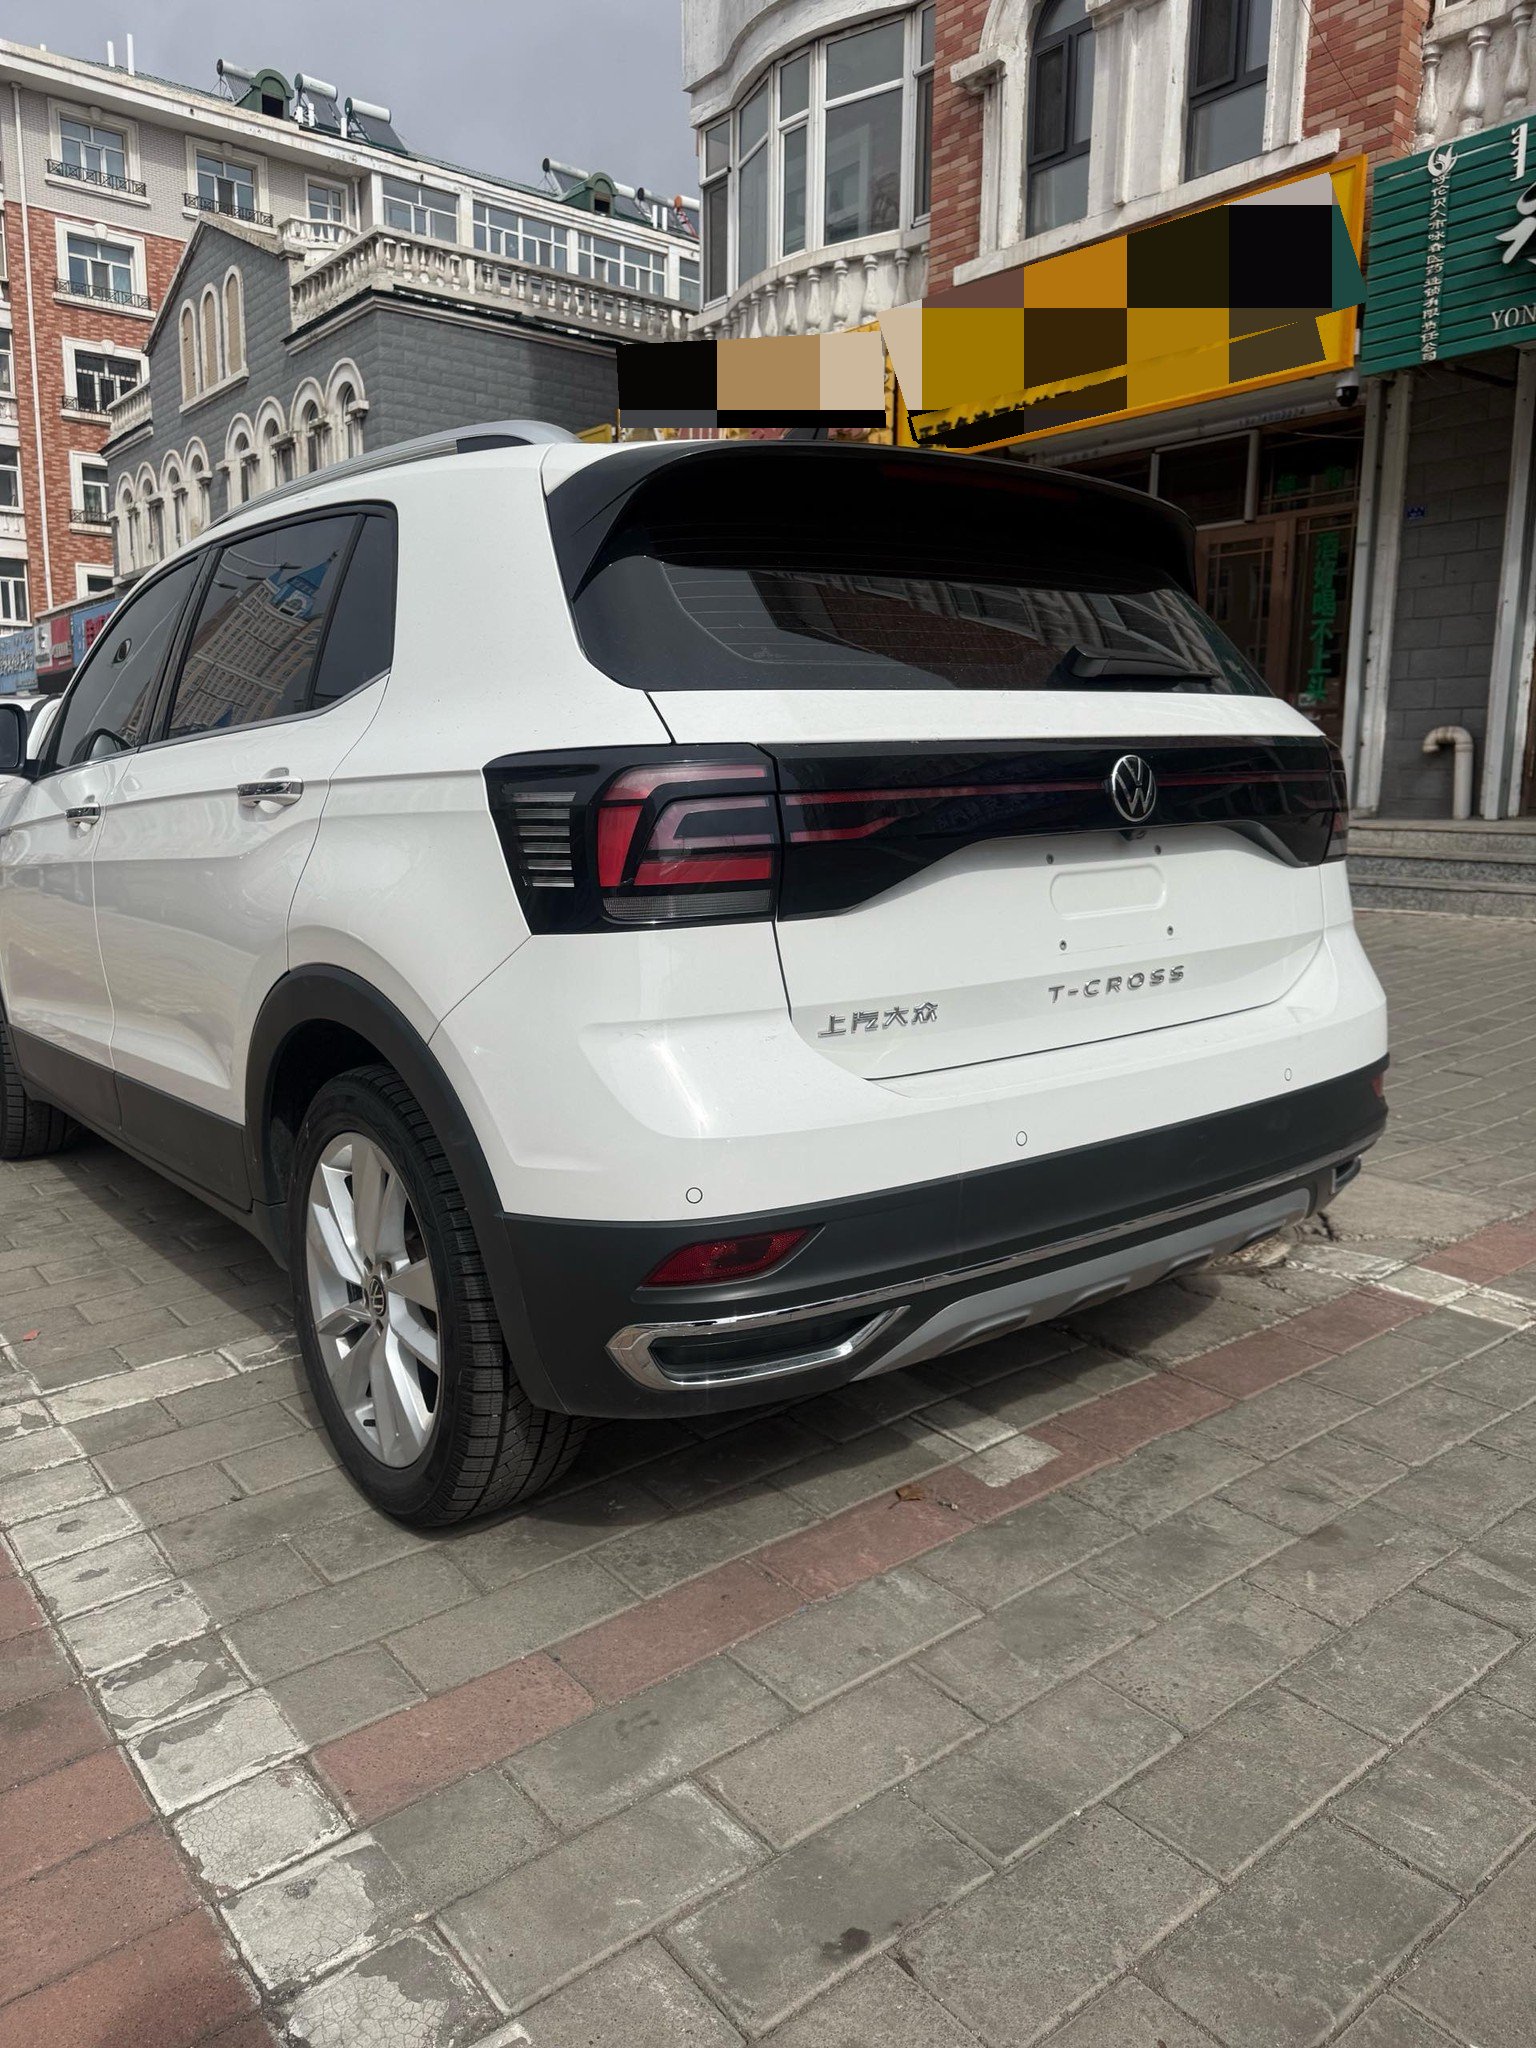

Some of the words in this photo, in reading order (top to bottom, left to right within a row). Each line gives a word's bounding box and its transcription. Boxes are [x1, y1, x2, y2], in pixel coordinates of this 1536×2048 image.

[1048, 965, 1185, 1004] T-CROSS
[817, 1001, 939, 1039] 上汽大众
